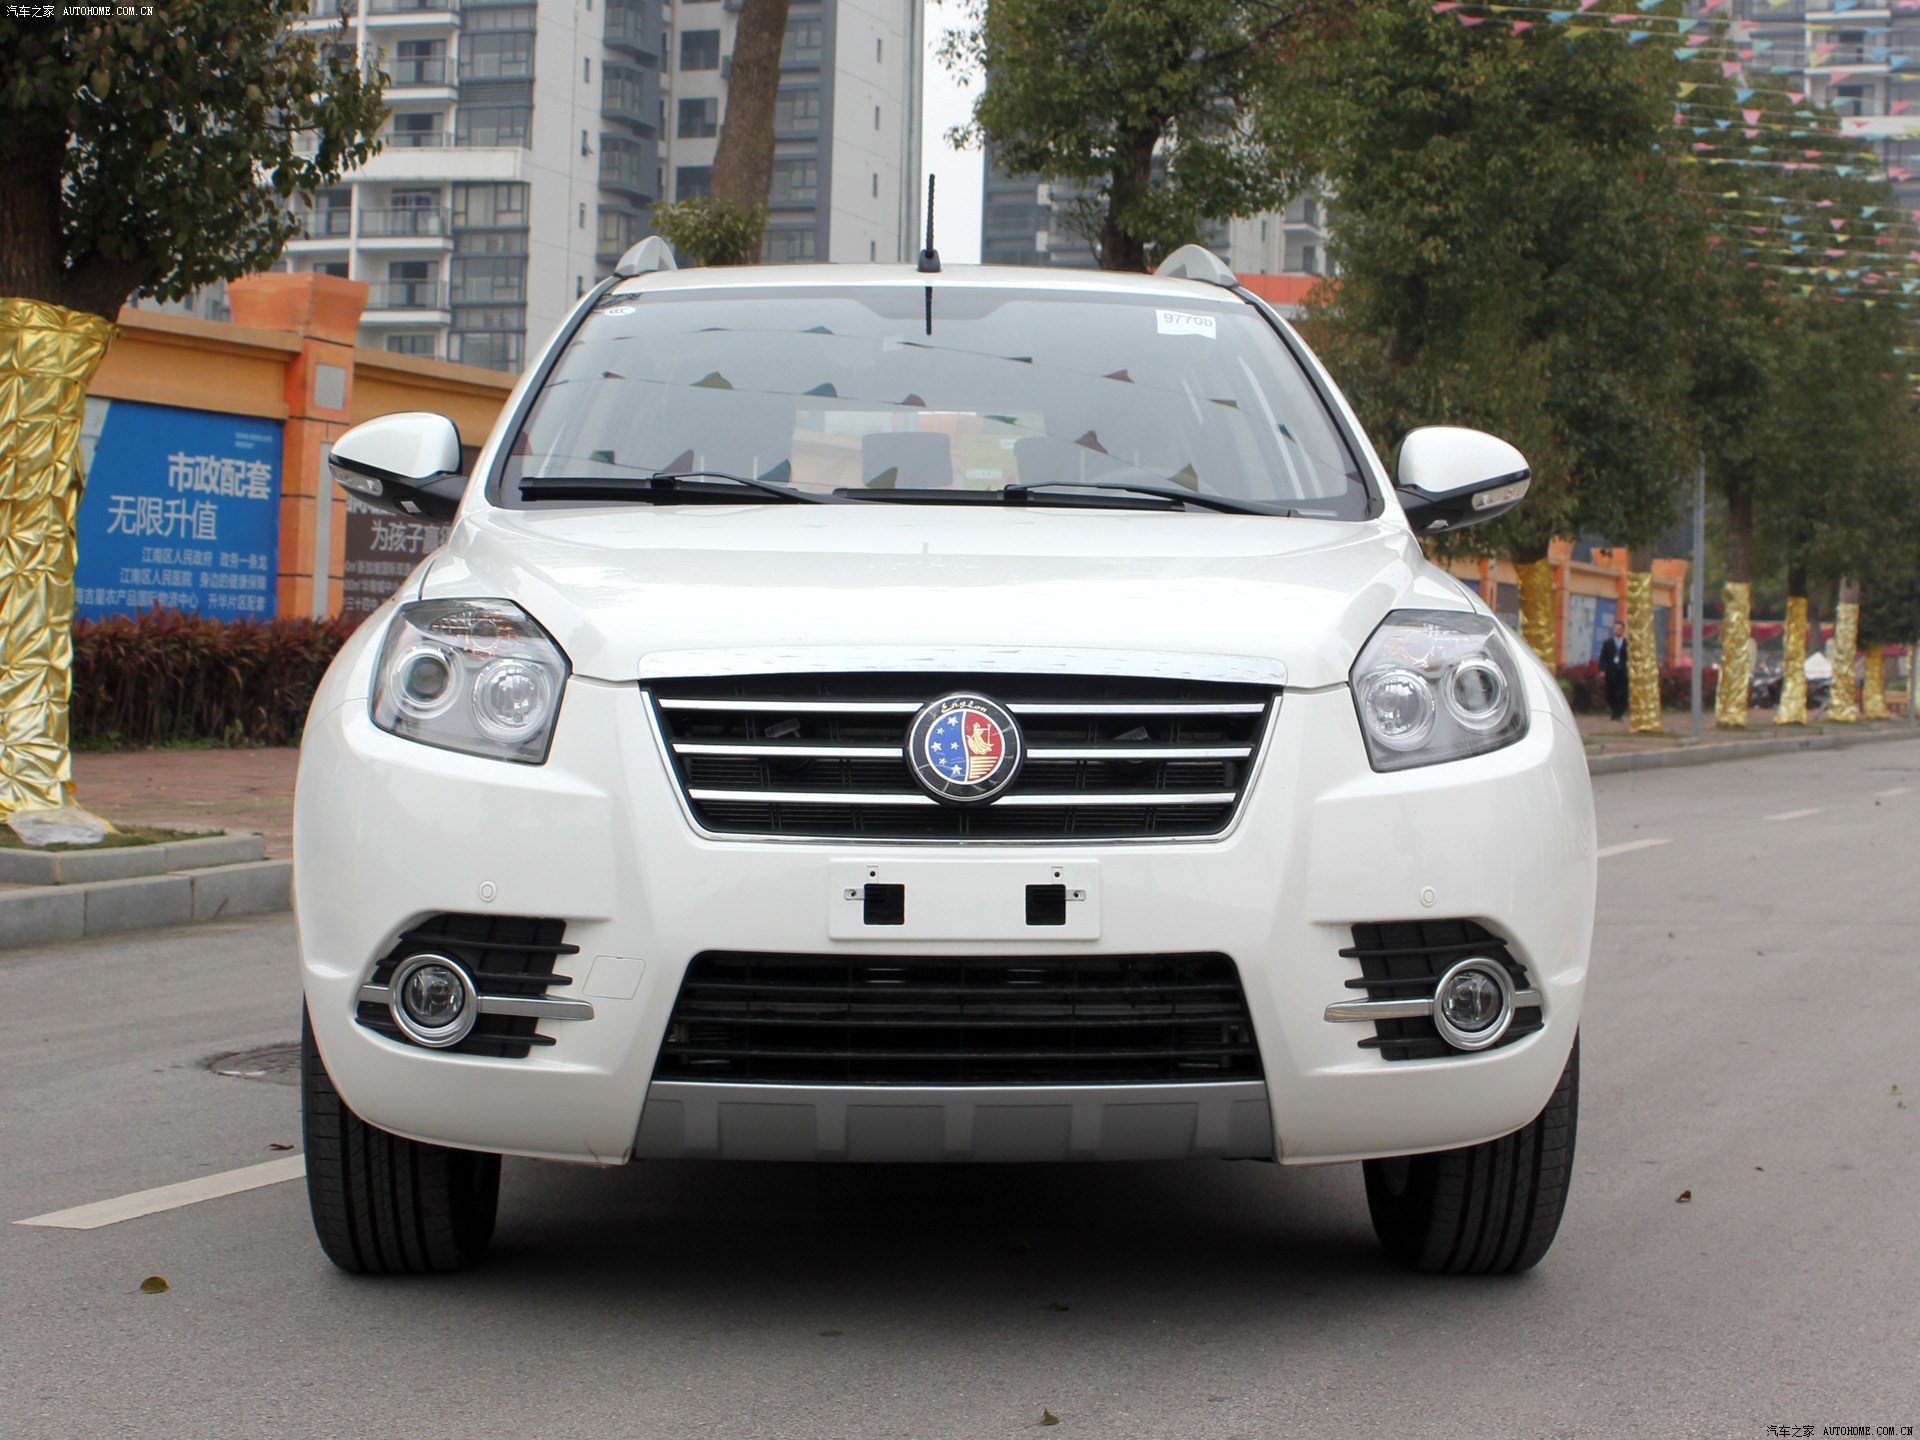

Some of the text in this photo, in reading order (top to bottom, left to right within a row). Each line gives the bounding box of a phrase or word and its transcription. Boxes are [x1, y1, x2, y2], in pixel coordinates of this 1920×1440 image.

[167, 451, 272, 500] 市政配套
[107, 495, 218, 540] 无限升值
[142, 547, 213, 567] 江南区人民政府
